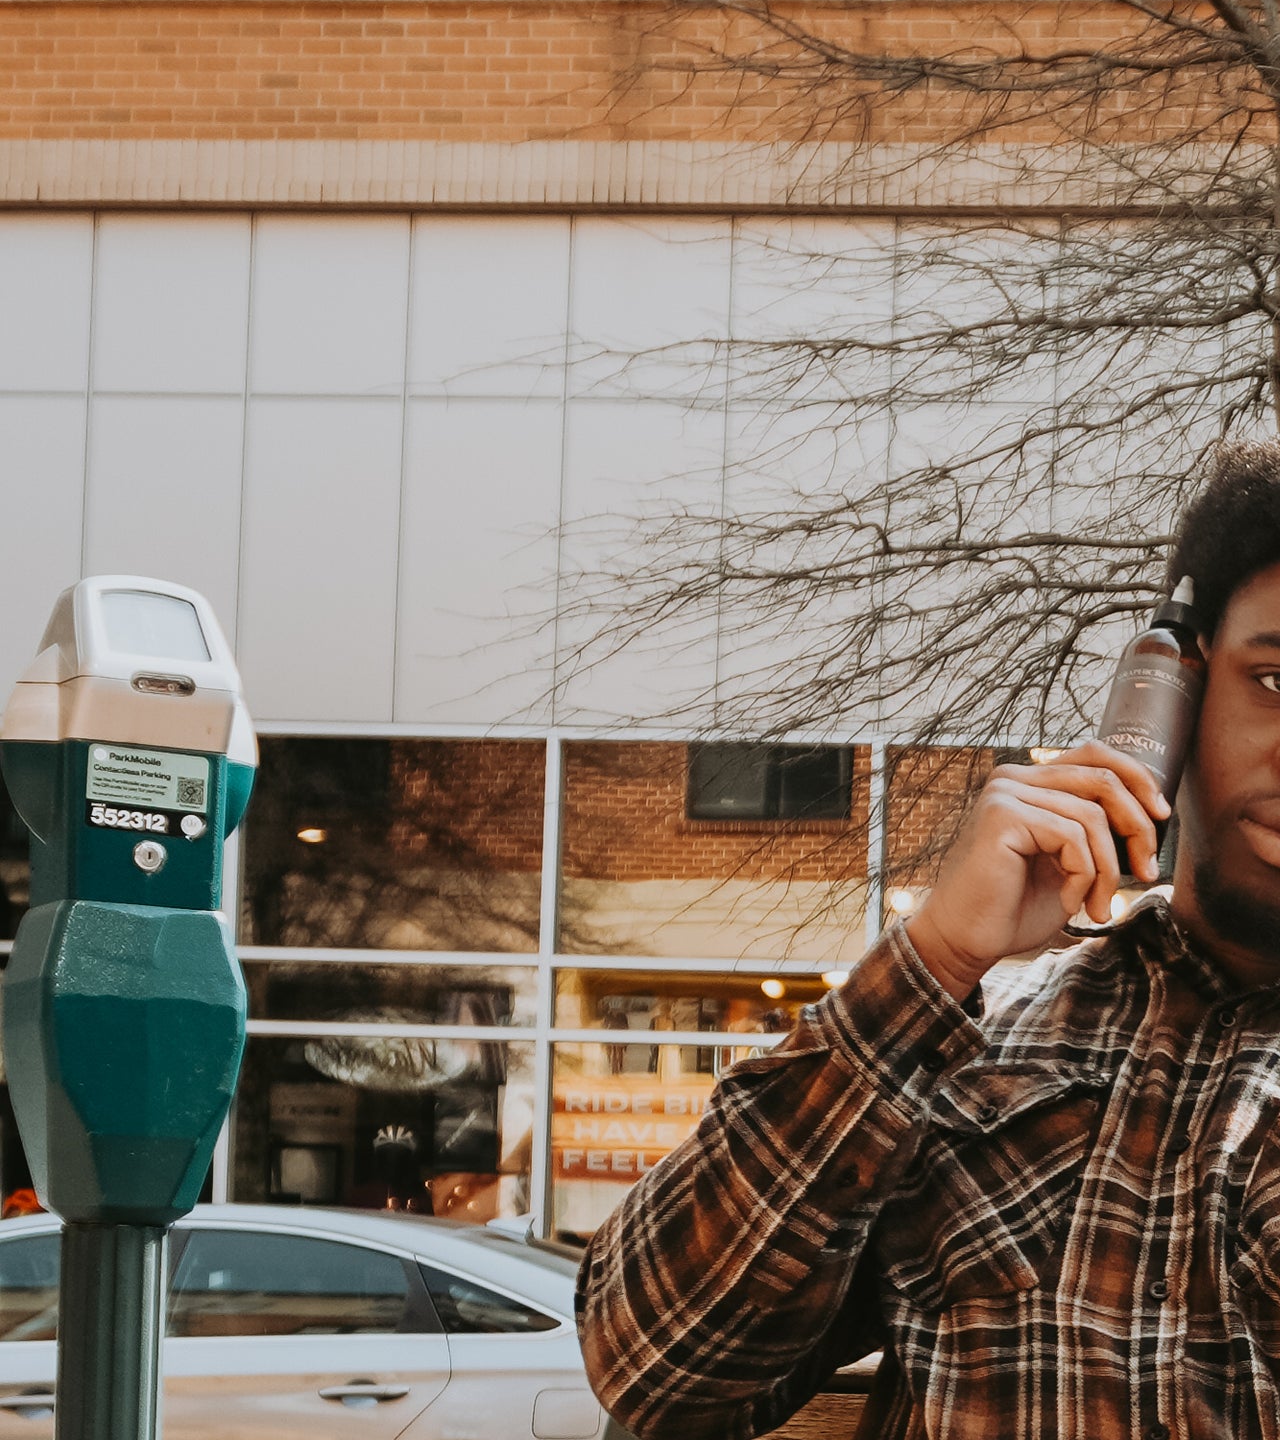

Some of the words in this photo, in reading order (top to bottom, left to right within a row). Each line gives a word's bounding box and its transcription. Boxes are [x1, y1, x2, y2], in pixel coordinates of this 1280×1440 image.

[1102, 733, 1167, 756] TRENGTH
[109, 752, 161, 766] ParkMobile
[141, 770, 171, 781] Parking
[91, 807, 167, 832] 552312
[565, 1091, 655, 1114] RIDE
[574, 1121, 677, 1145] HAVE
[562, 1148, 652, 1172] FEEL
